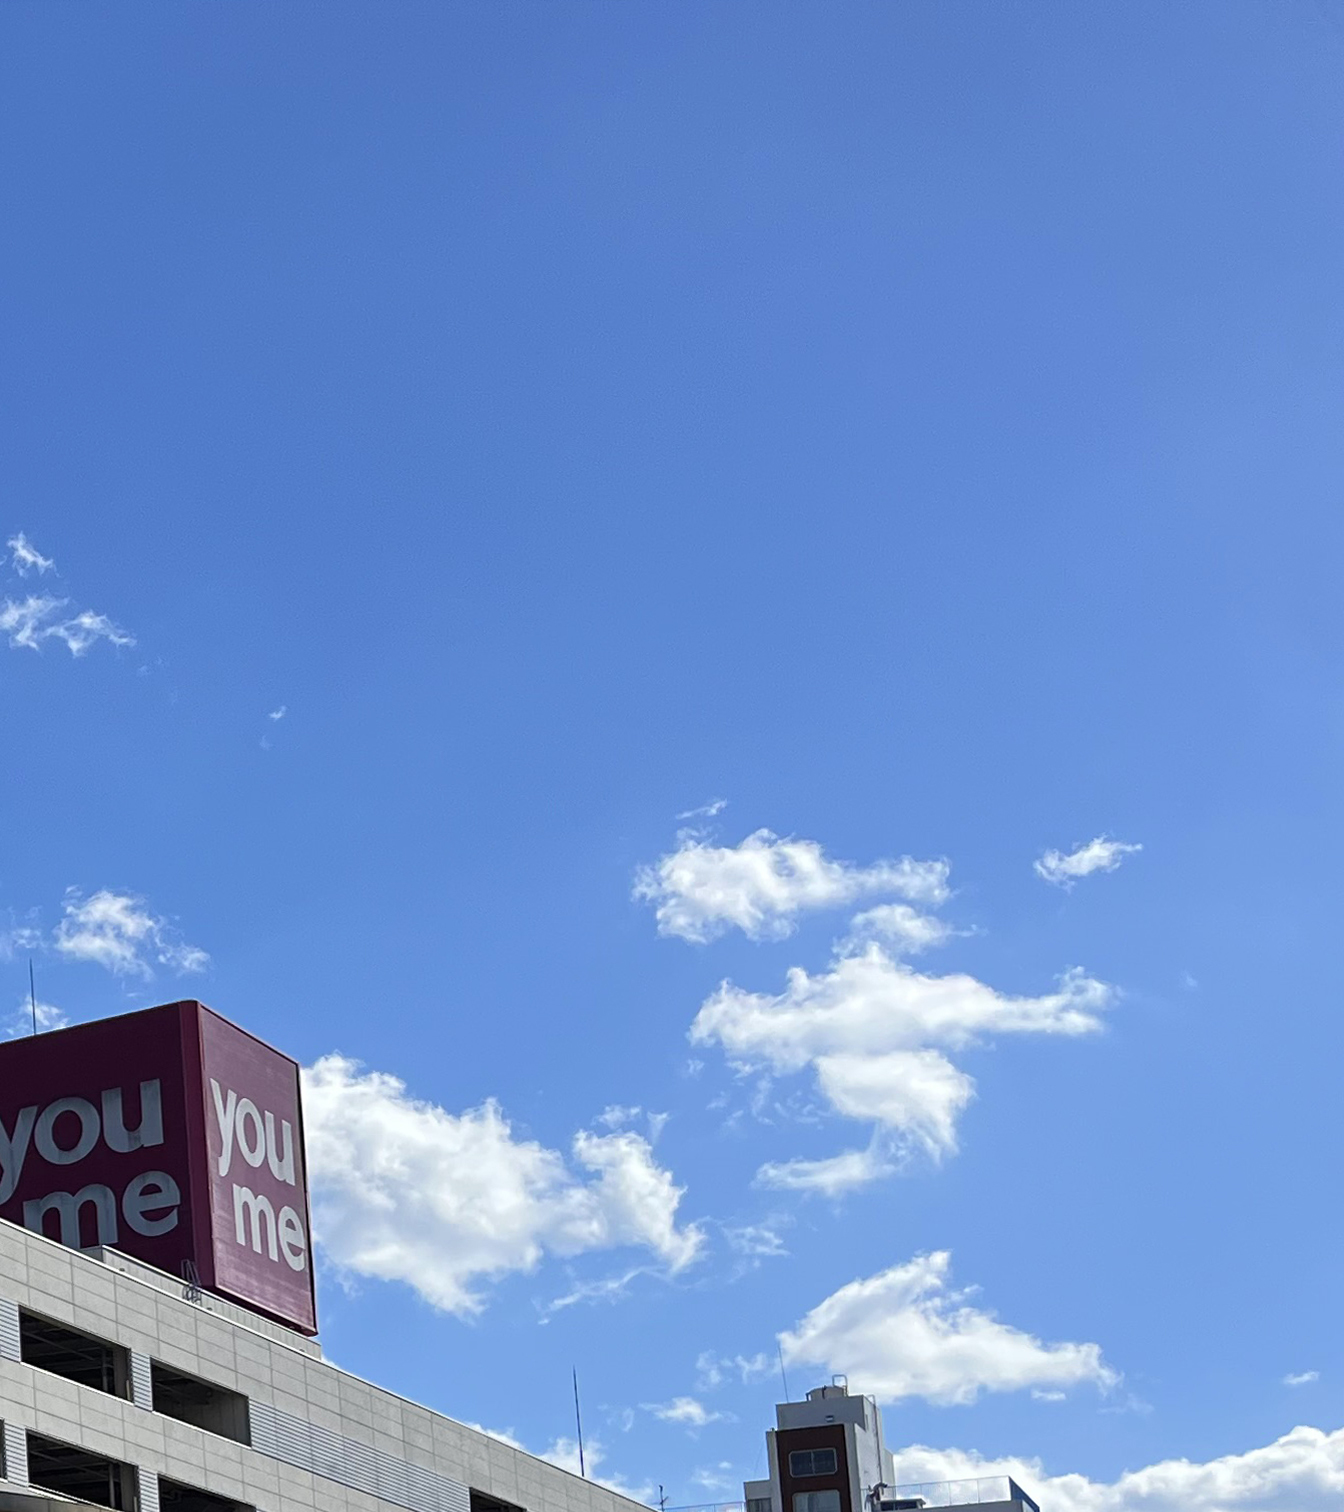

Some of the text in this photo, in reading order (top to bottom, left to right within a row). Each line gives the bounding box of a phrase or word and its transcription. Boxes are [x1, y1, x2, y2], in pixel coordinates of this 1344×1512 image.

[210, 1077, 296, 1187] you
[23, 1170, 181, 1250] me
[232, 1182, 307, 1272] me
